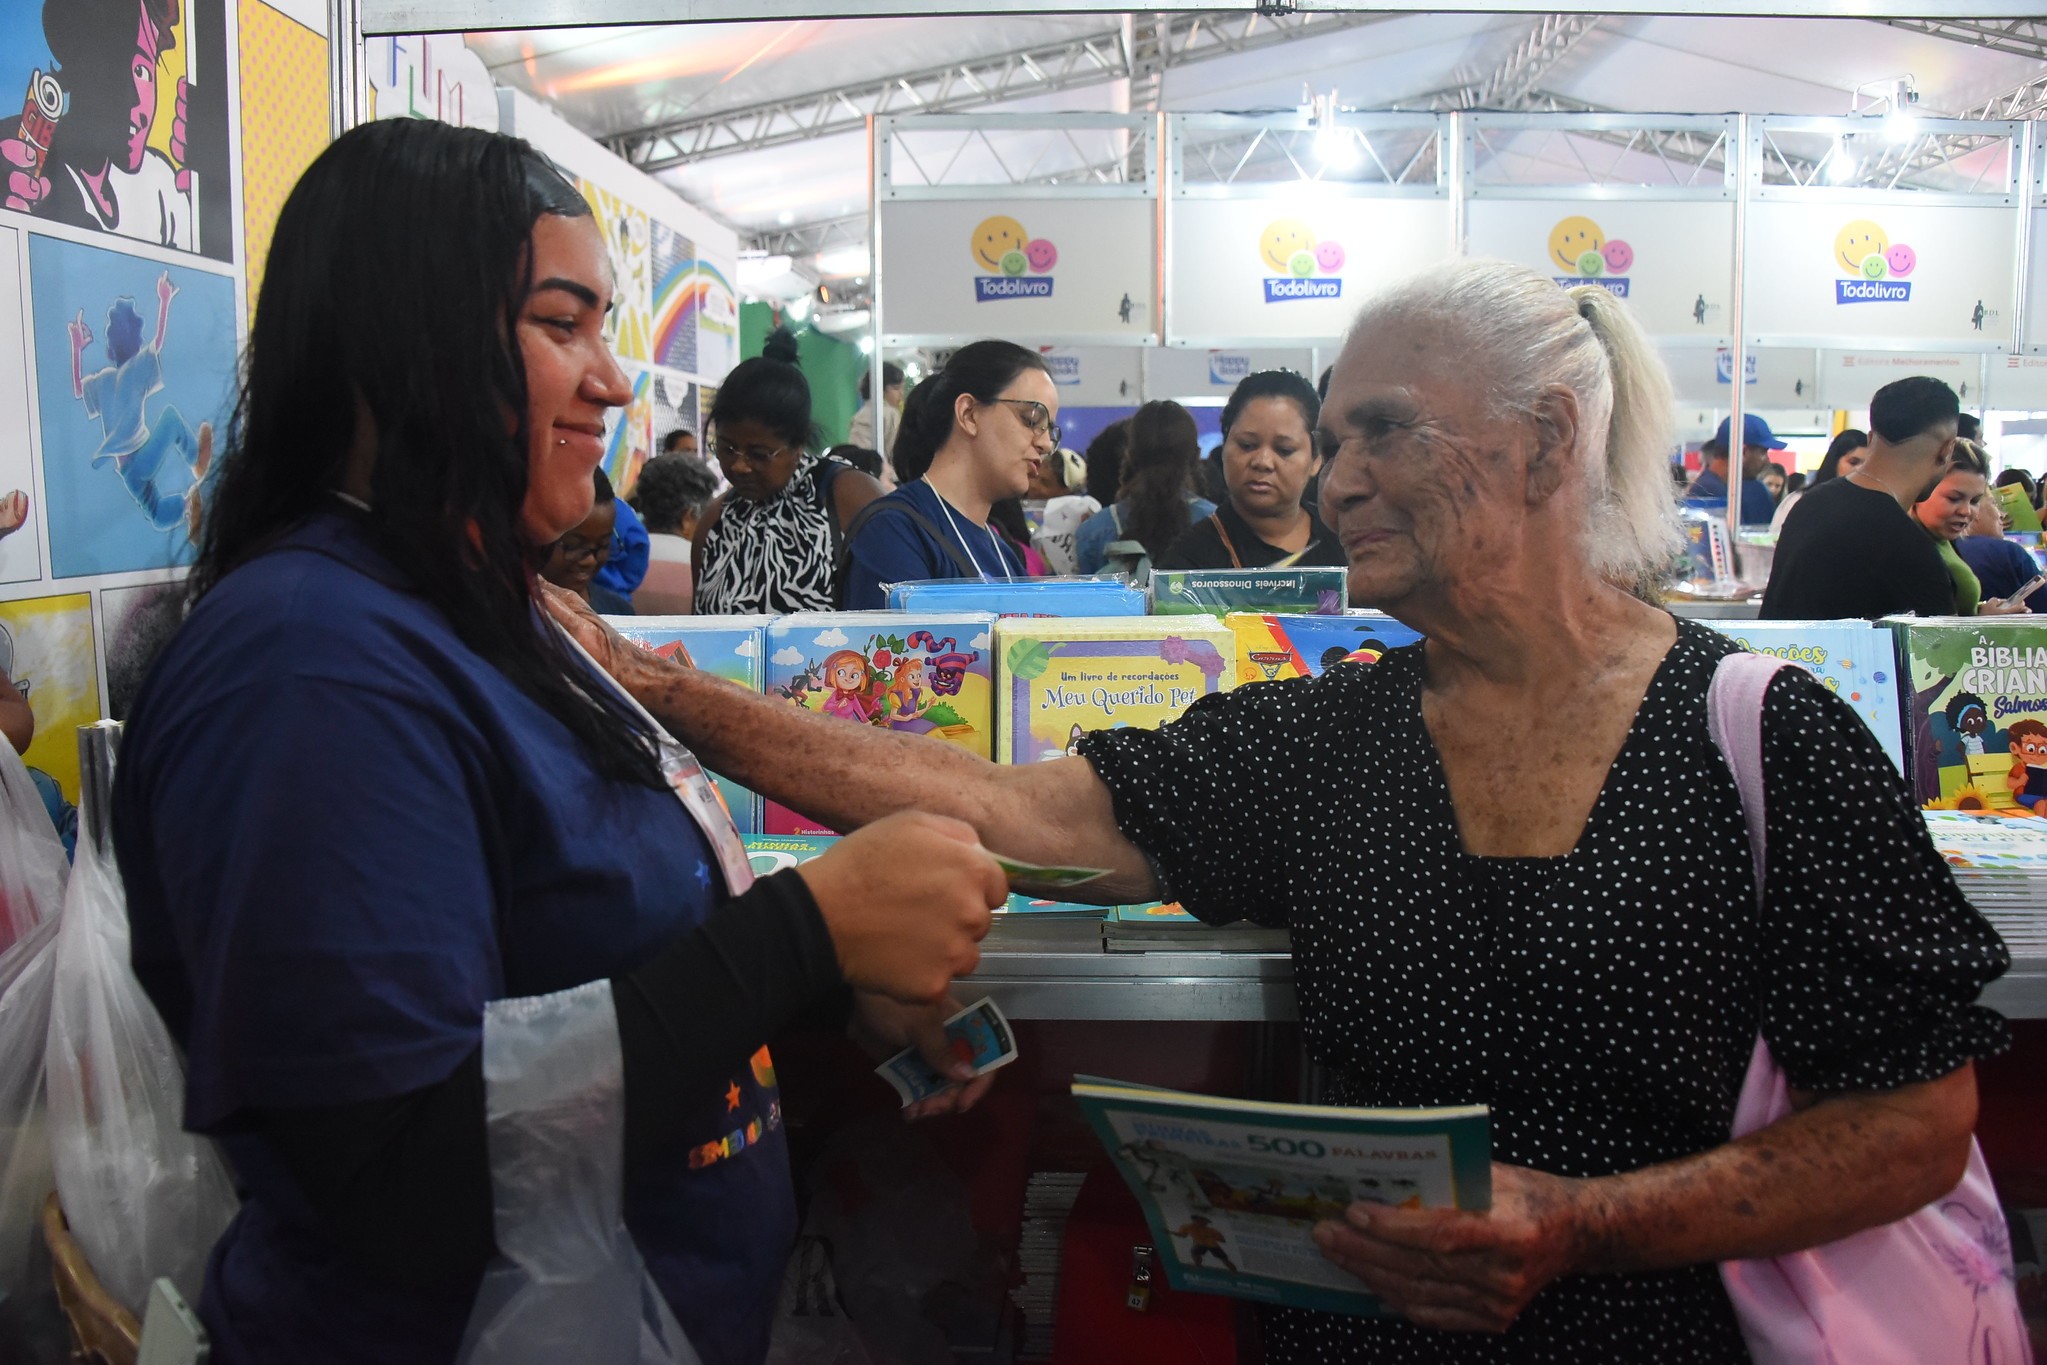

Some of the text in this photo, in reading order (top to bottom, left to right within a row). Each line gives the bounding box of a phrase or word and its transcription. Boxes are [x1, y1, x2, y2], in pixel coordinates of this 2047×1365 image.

[980, 278, 1050, 295] Todolivro
[1267, 280, 1339, 297] Todolivro
[1840, 281, 1907, 299] Todolivro
[1891, 357, 1960, 367] Melhoramentos
[1191, 579, 1252, 590] Dinossauros
[1979, 635, 1987, 645] A
[1970, 640, 2047, 668] BÍBLIA
[1061, 671, 1179, 682] Um livro de recordações
[1041, 683, 1196, 715] Meu Querido Pet
[1993, 695, 2047, 719] Salmos
[793, 827, 801, 835] 2
[1246, 1133, 1326, 1159] 500
[1331, 1146, 1437, 1160] PALAVRAS
